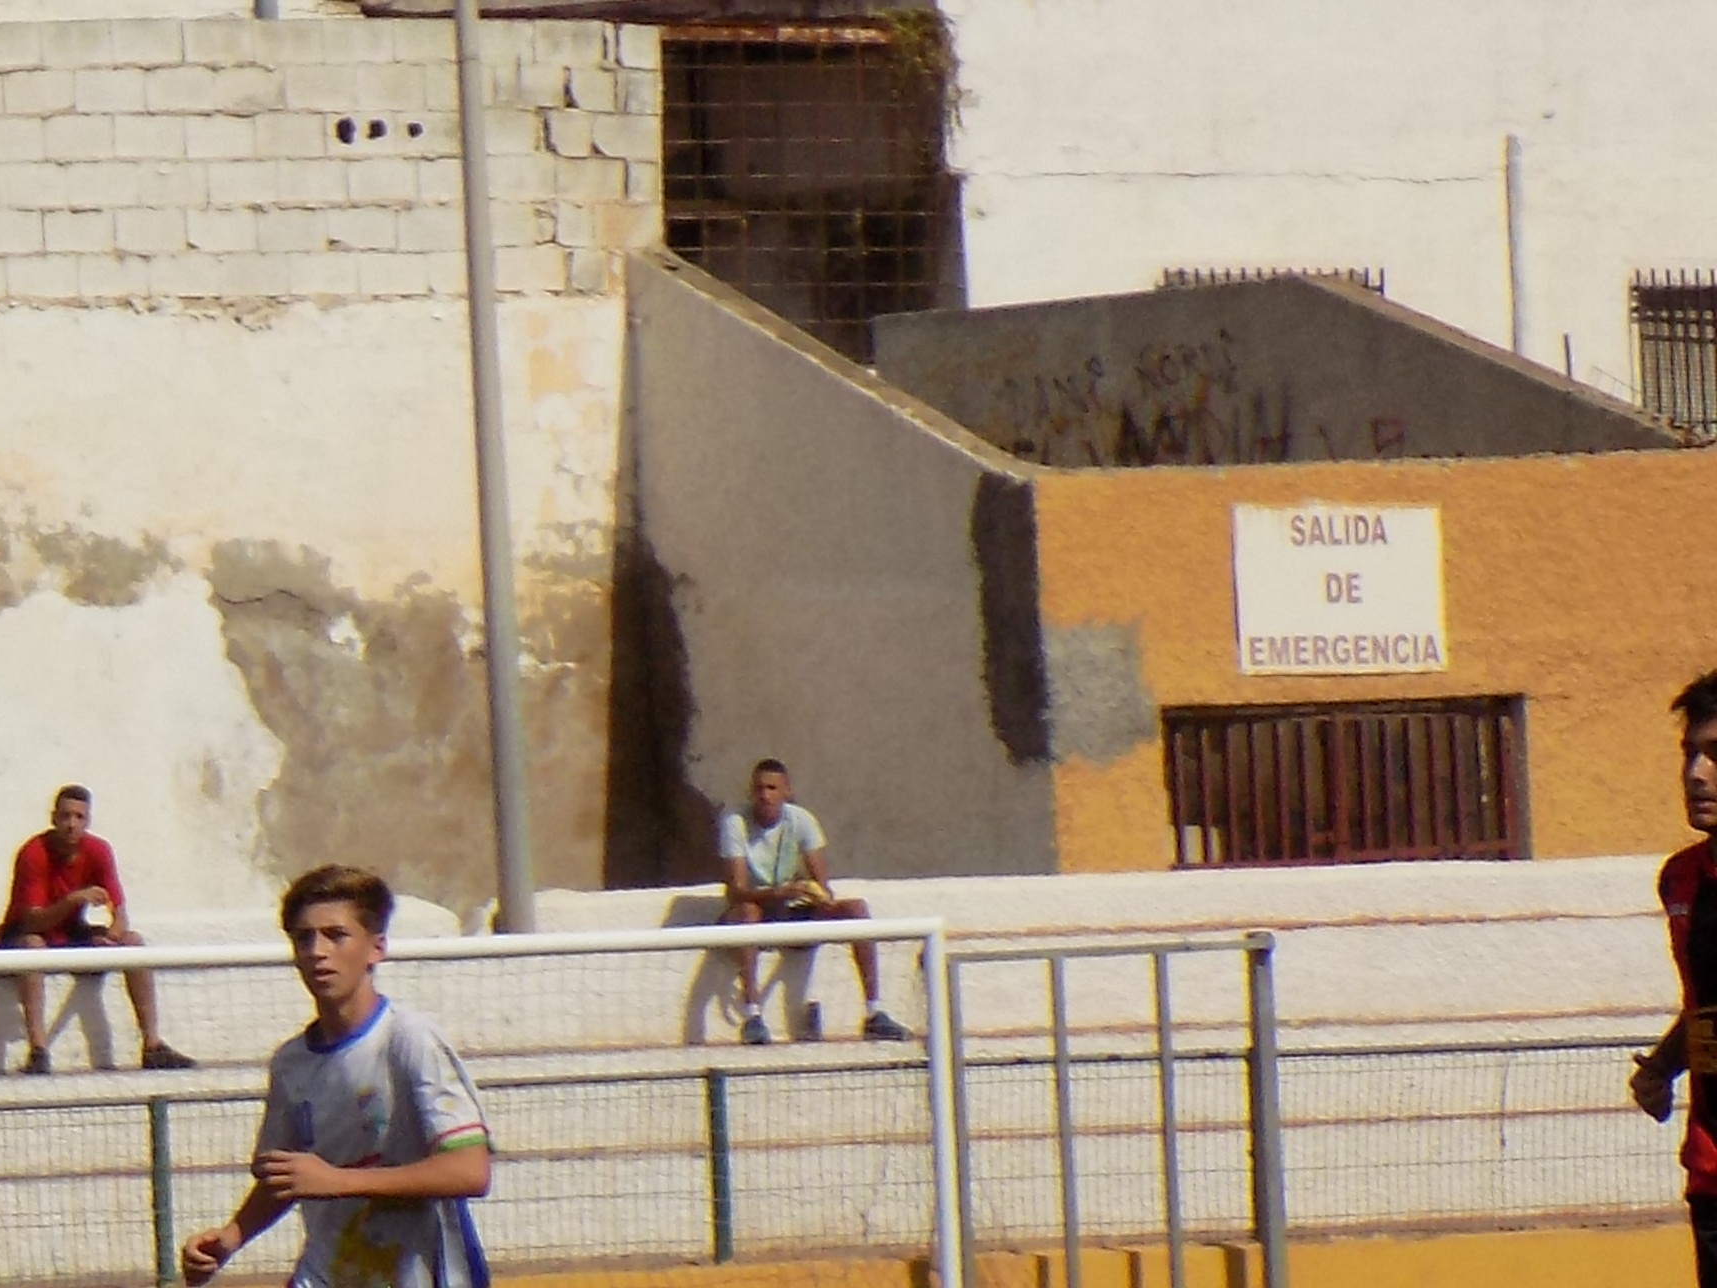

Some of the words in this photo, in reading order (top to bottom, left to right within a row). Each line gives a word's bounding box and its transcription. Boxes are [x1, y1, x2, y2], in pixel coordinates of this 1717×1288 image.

[1289, 513, 1388, 546] SALIDA
[1325, 572, 1363, 603] DE
[1248, 633, 1441, 666] EMERGENCIA
